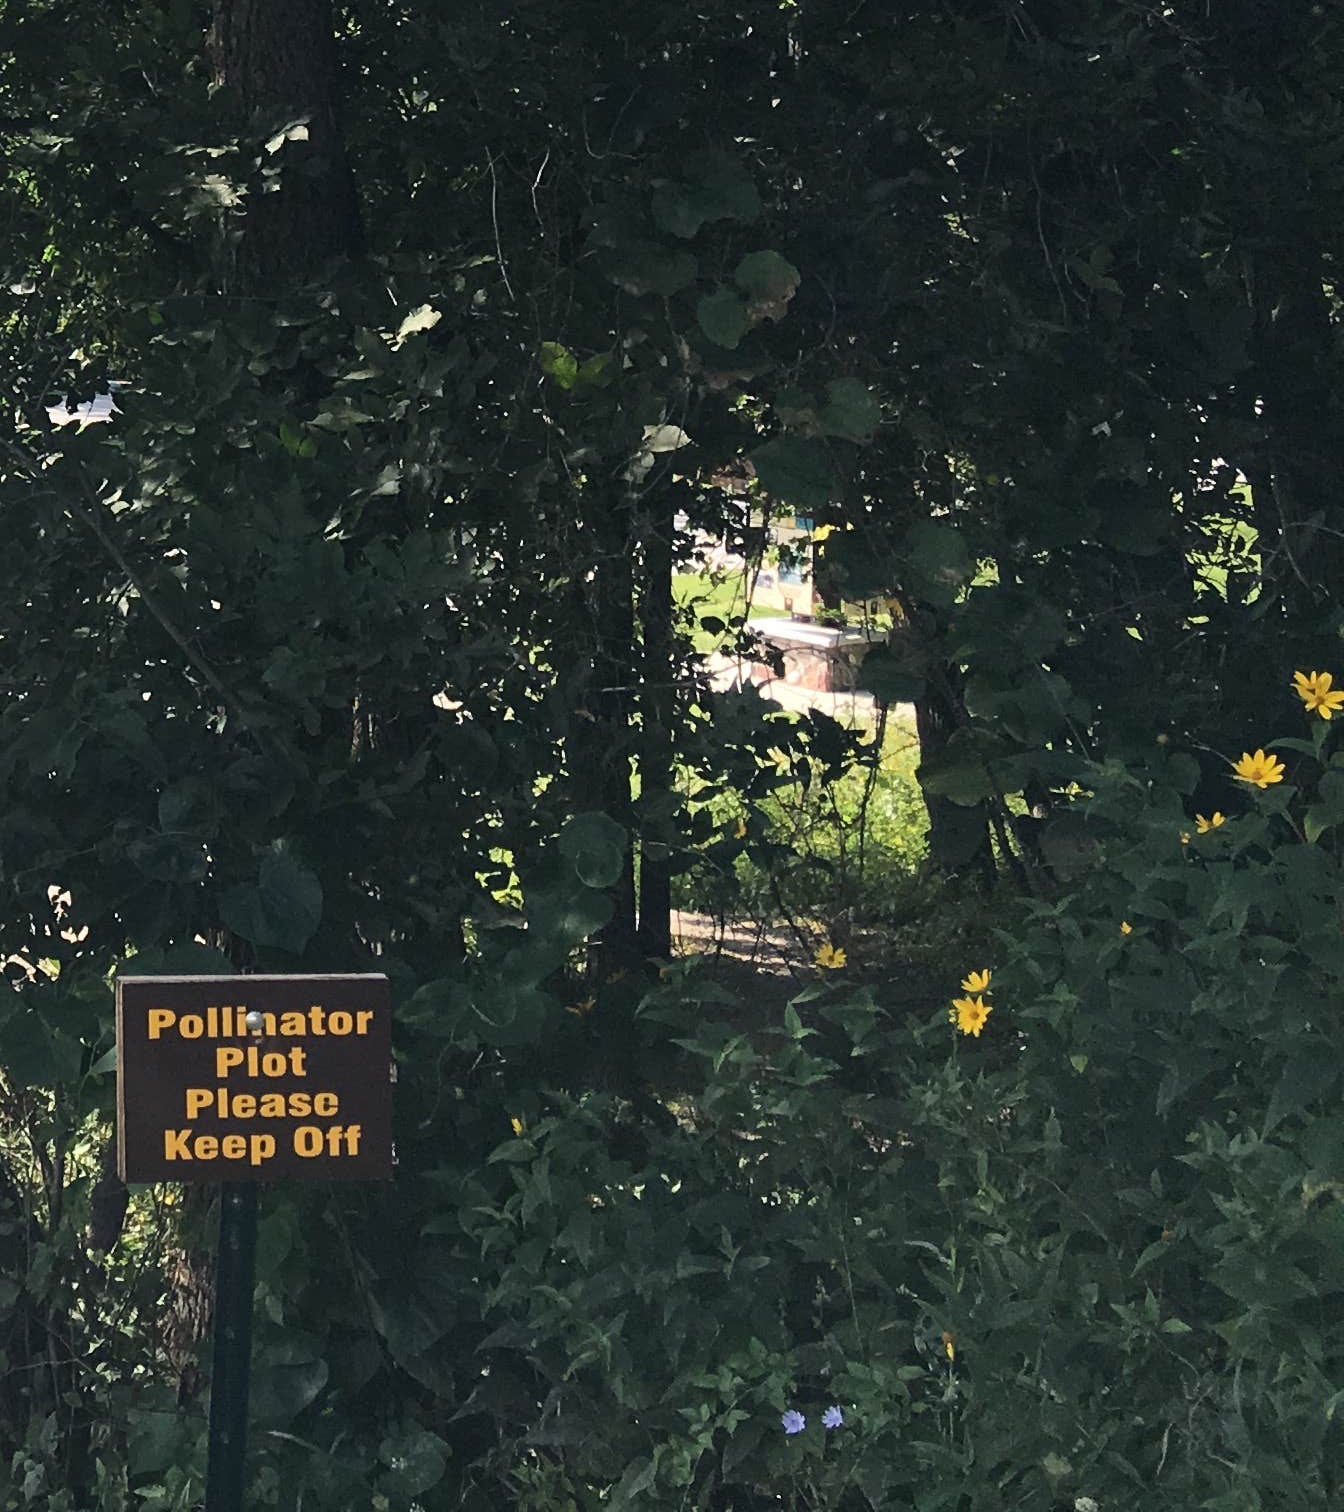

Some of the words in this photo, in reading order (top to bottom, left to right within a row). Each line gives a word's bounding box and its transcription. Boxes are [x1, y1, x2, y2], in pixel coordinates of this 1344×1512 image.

[148, 1006, 373, 1039] Pollinator
[216, 1046, 306, 1078] Plot
[186, 1088, 339, 1119] Please
[164, 1129, 276, 1166] Keep
[294, 1125, 361, 1158] Off
